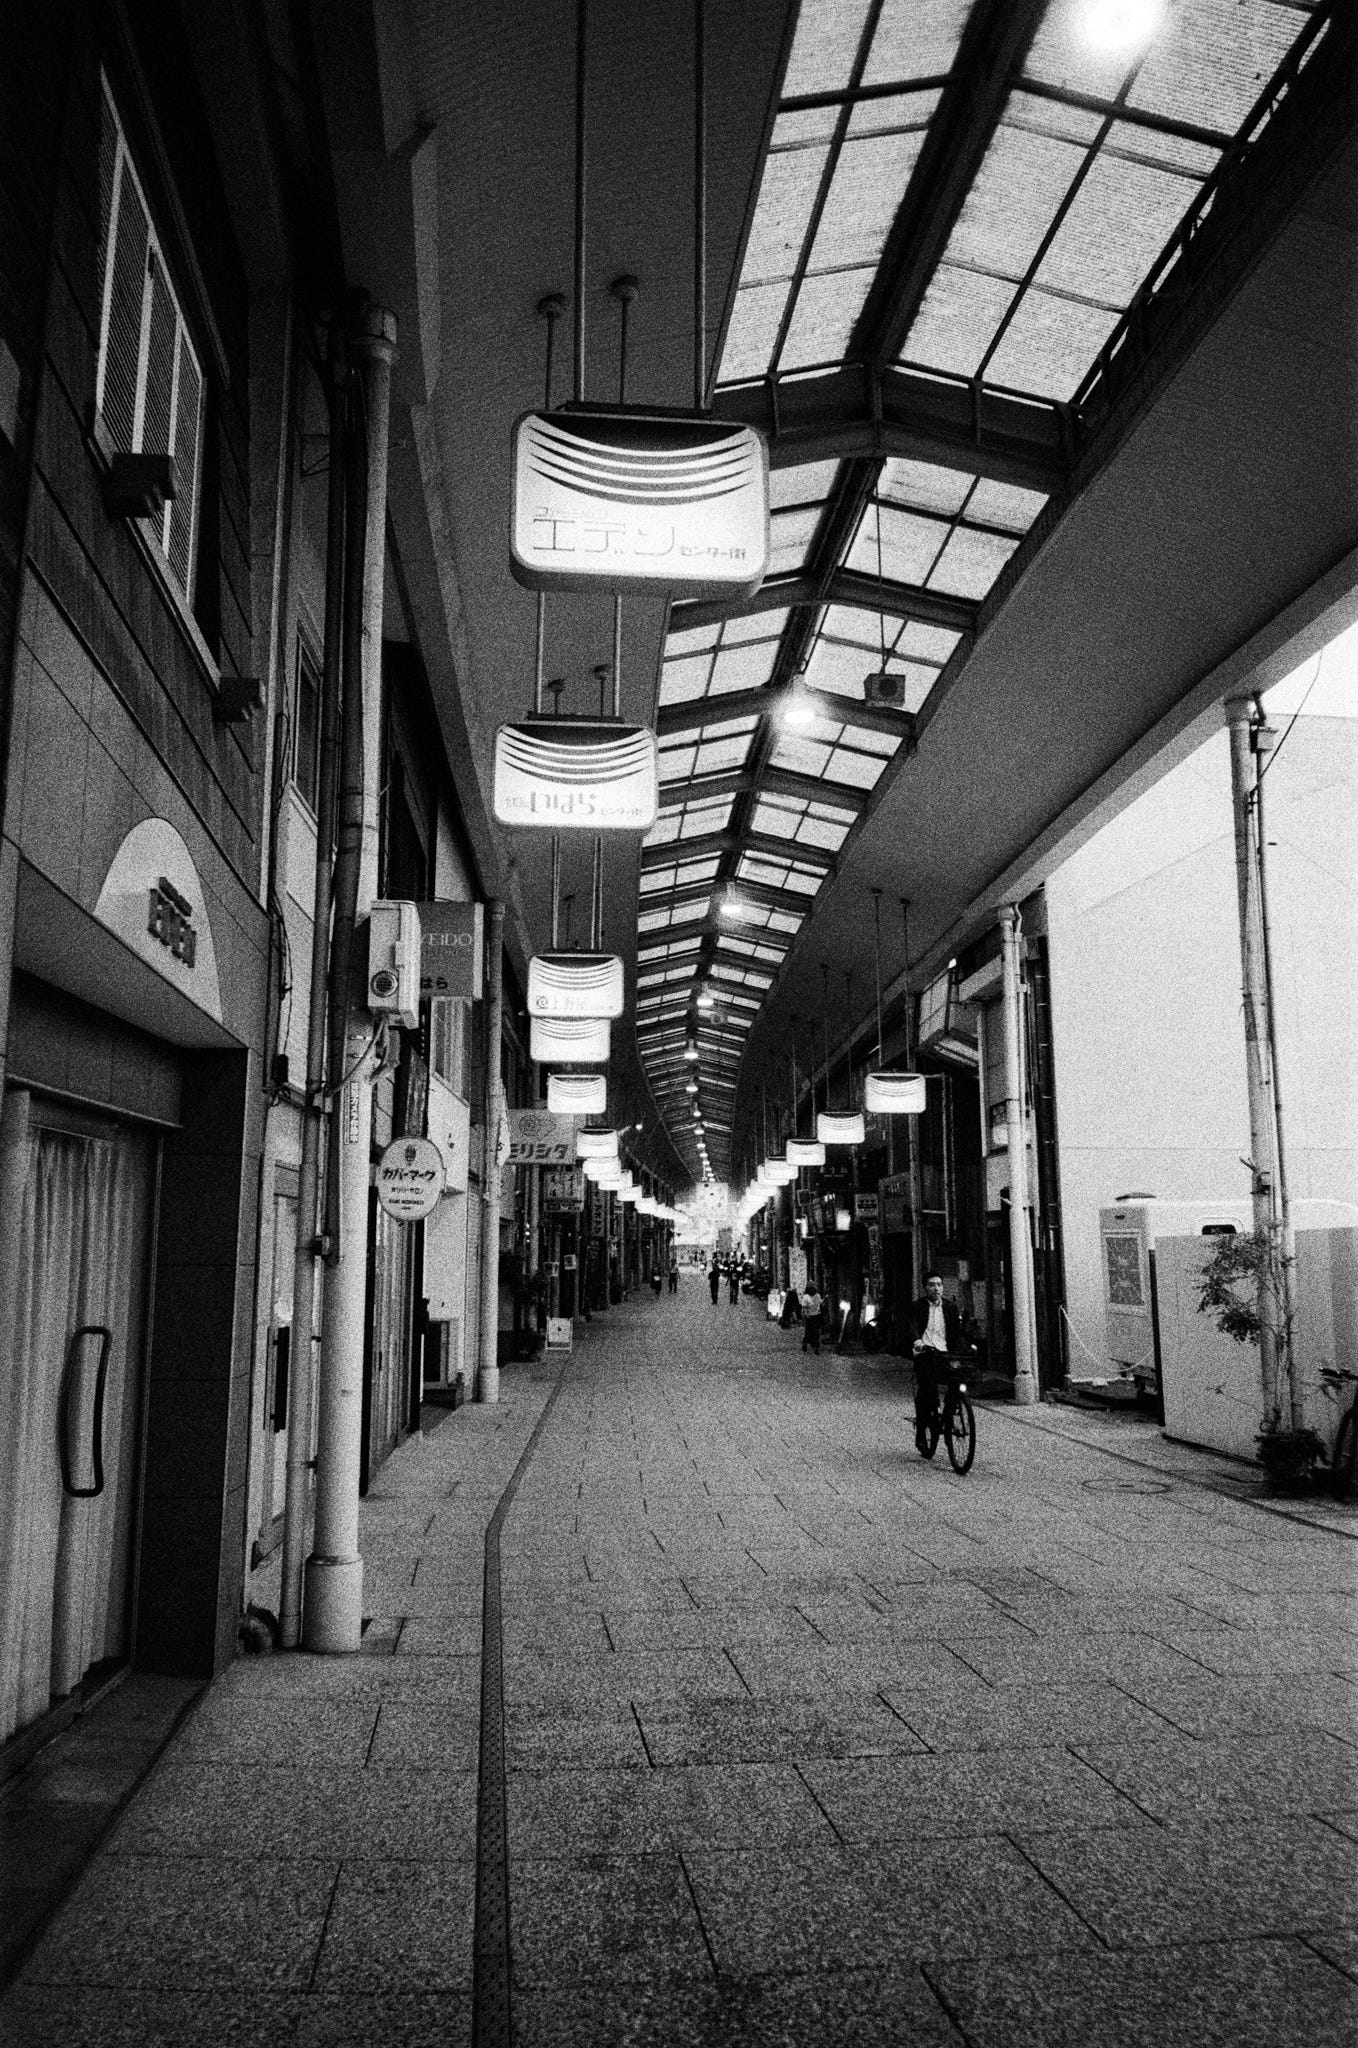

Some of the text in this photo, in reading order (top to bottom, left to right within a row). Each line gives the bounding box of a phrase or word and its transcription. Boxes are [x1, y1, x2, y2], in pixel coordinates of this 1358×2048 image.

[532, 517, 675, 556] エデン
[421, 932, 474, 947] EIDO
[382, 1167, 437, 1182] カバーマーク
